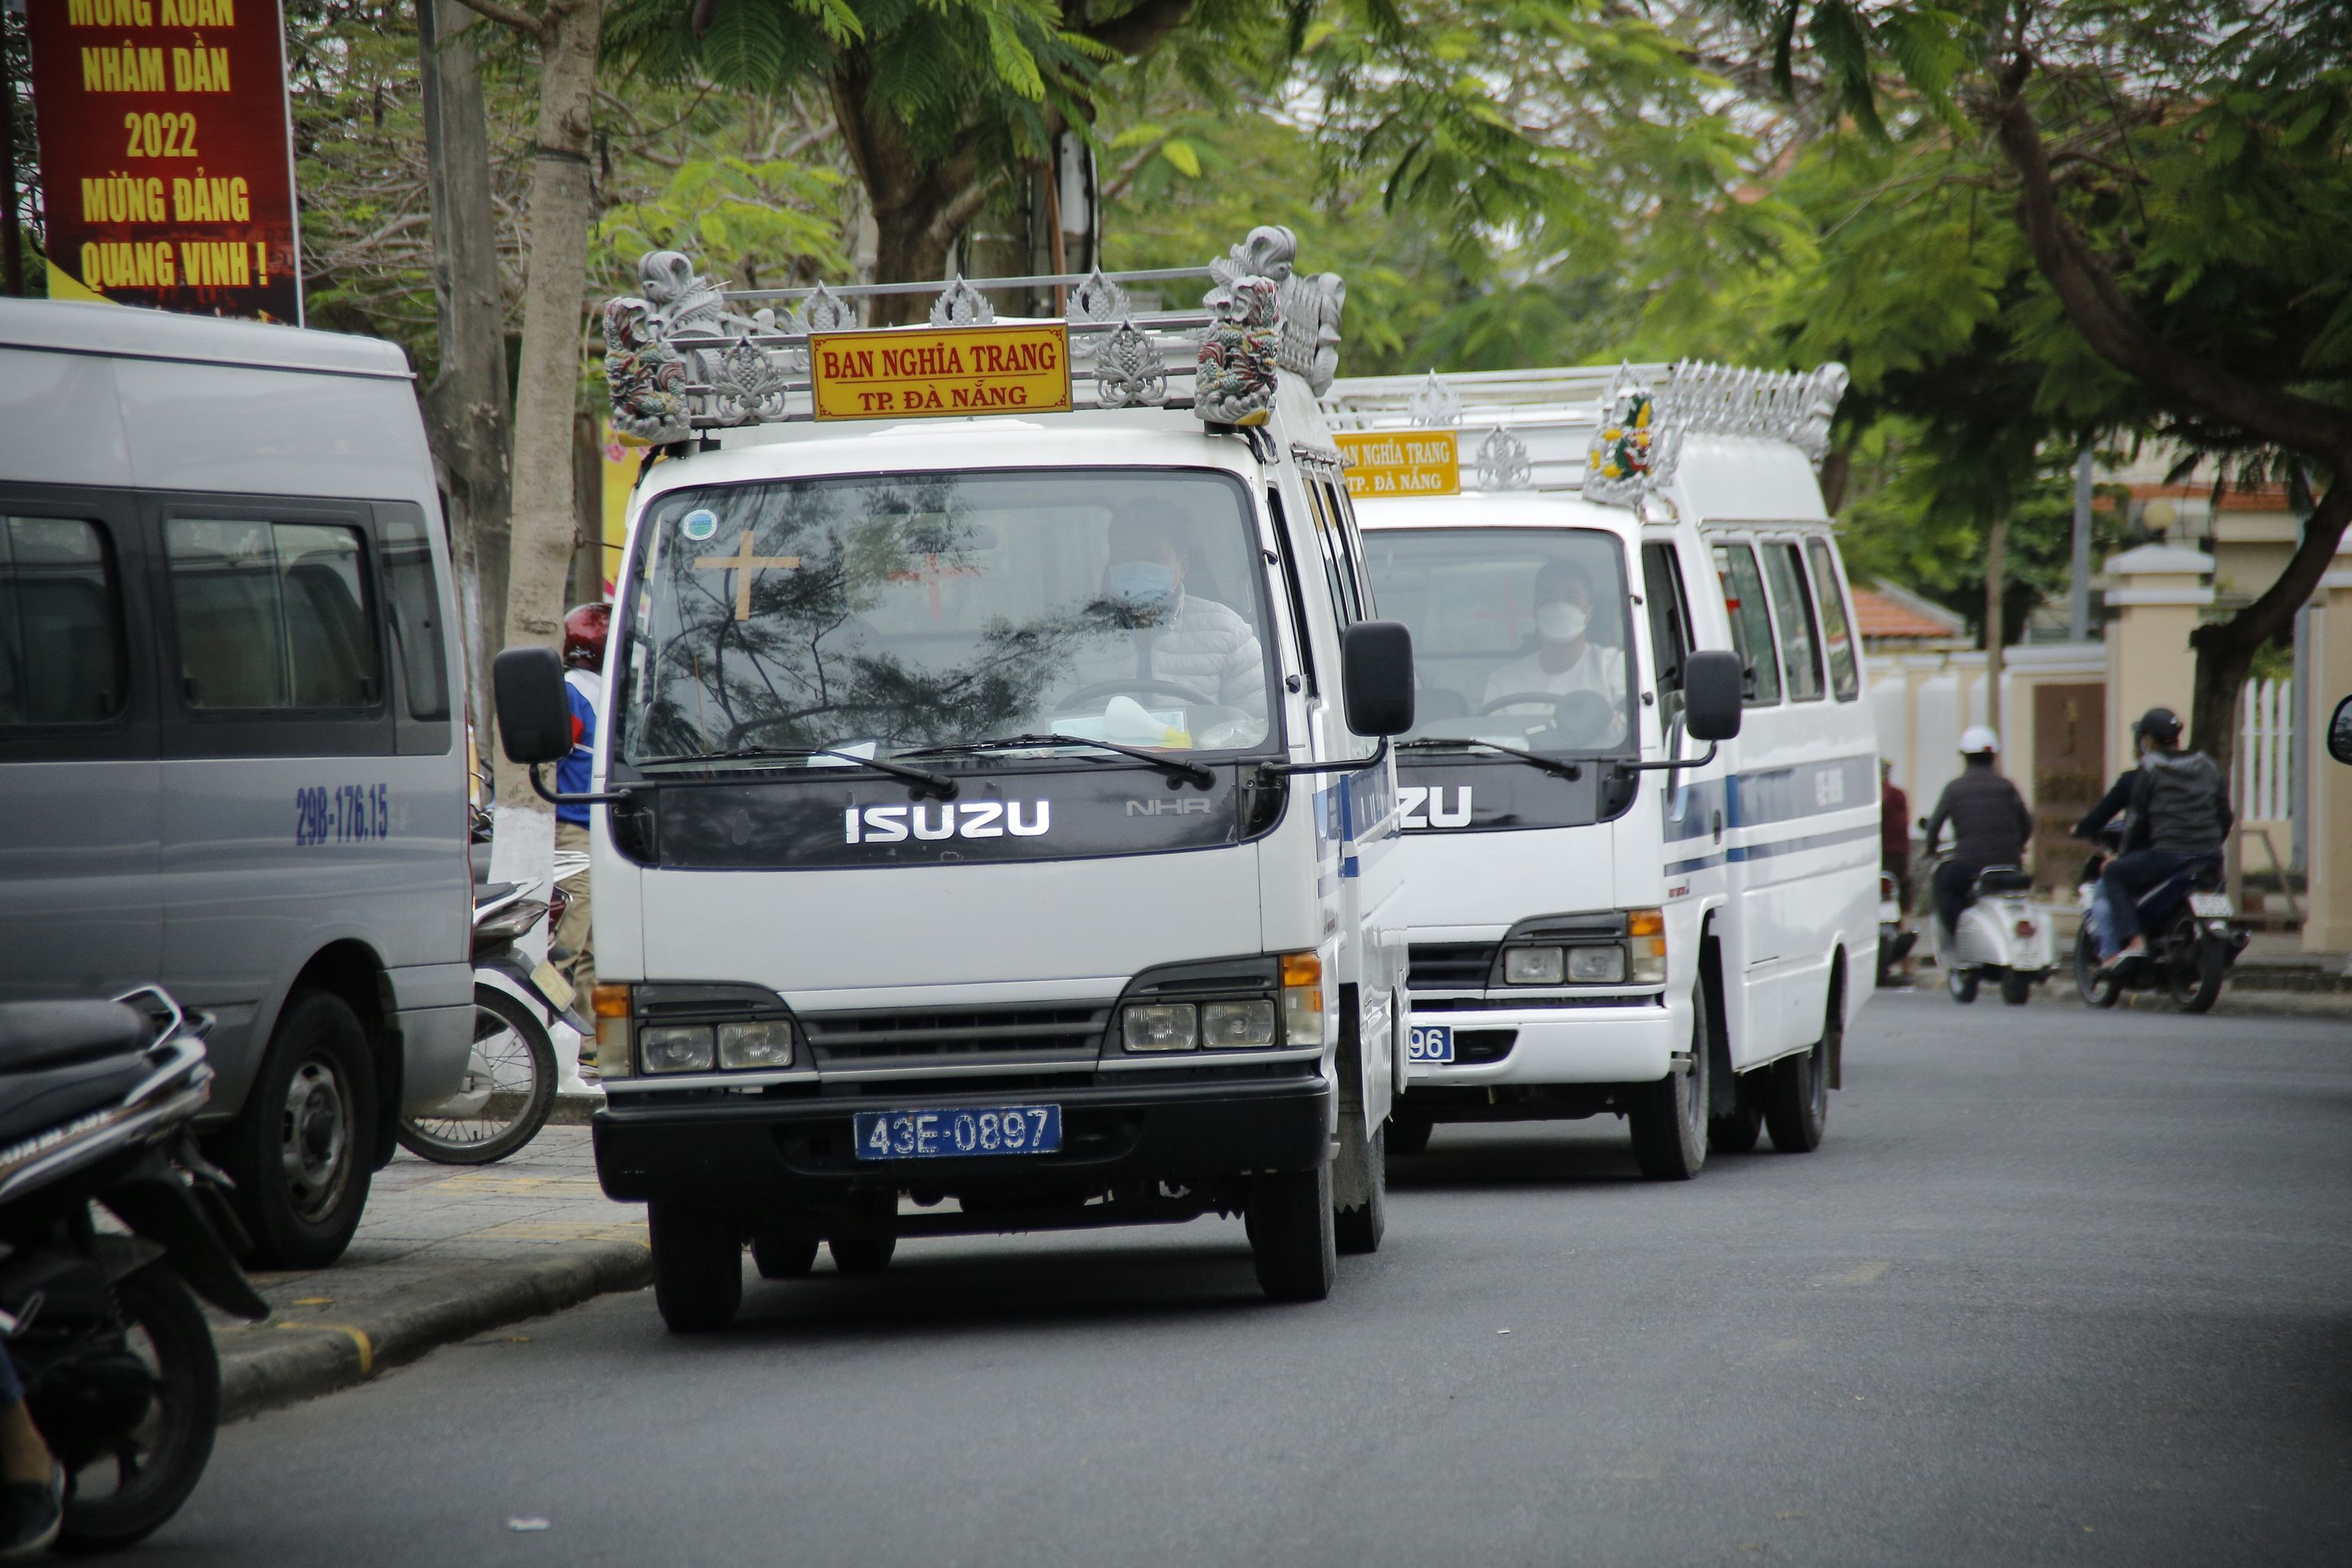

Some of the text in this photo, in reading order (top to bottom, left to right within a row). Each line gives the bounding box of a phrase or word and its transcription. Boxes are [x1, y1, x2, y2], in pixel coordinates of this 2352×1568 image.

[81, 33, 230, 92] NHÂM DẦN
[125, 113, 198, 157] 2022
[81, 167, 250, 222] MỪNG ĐẢNG
[81, 242, 176, 292] QUANG
[181, 242, 250, 286] VINH
[823, 341, 1057, 379] BAN NGHĨA TRANG
[858, 379, 1027, 411] TP. ĐÀ NẴNG
[1362, 439, 1404, 466] NGHĨA
[1406, 441, 1450, 464] TRANG
[1374, 470, 1396, 491] ĐÀ
[296, 783, 388, 846] 29B-176.15
[846, 801, 1050, 844] ISUZU
[1125, 798, 1211, 816] NHR
